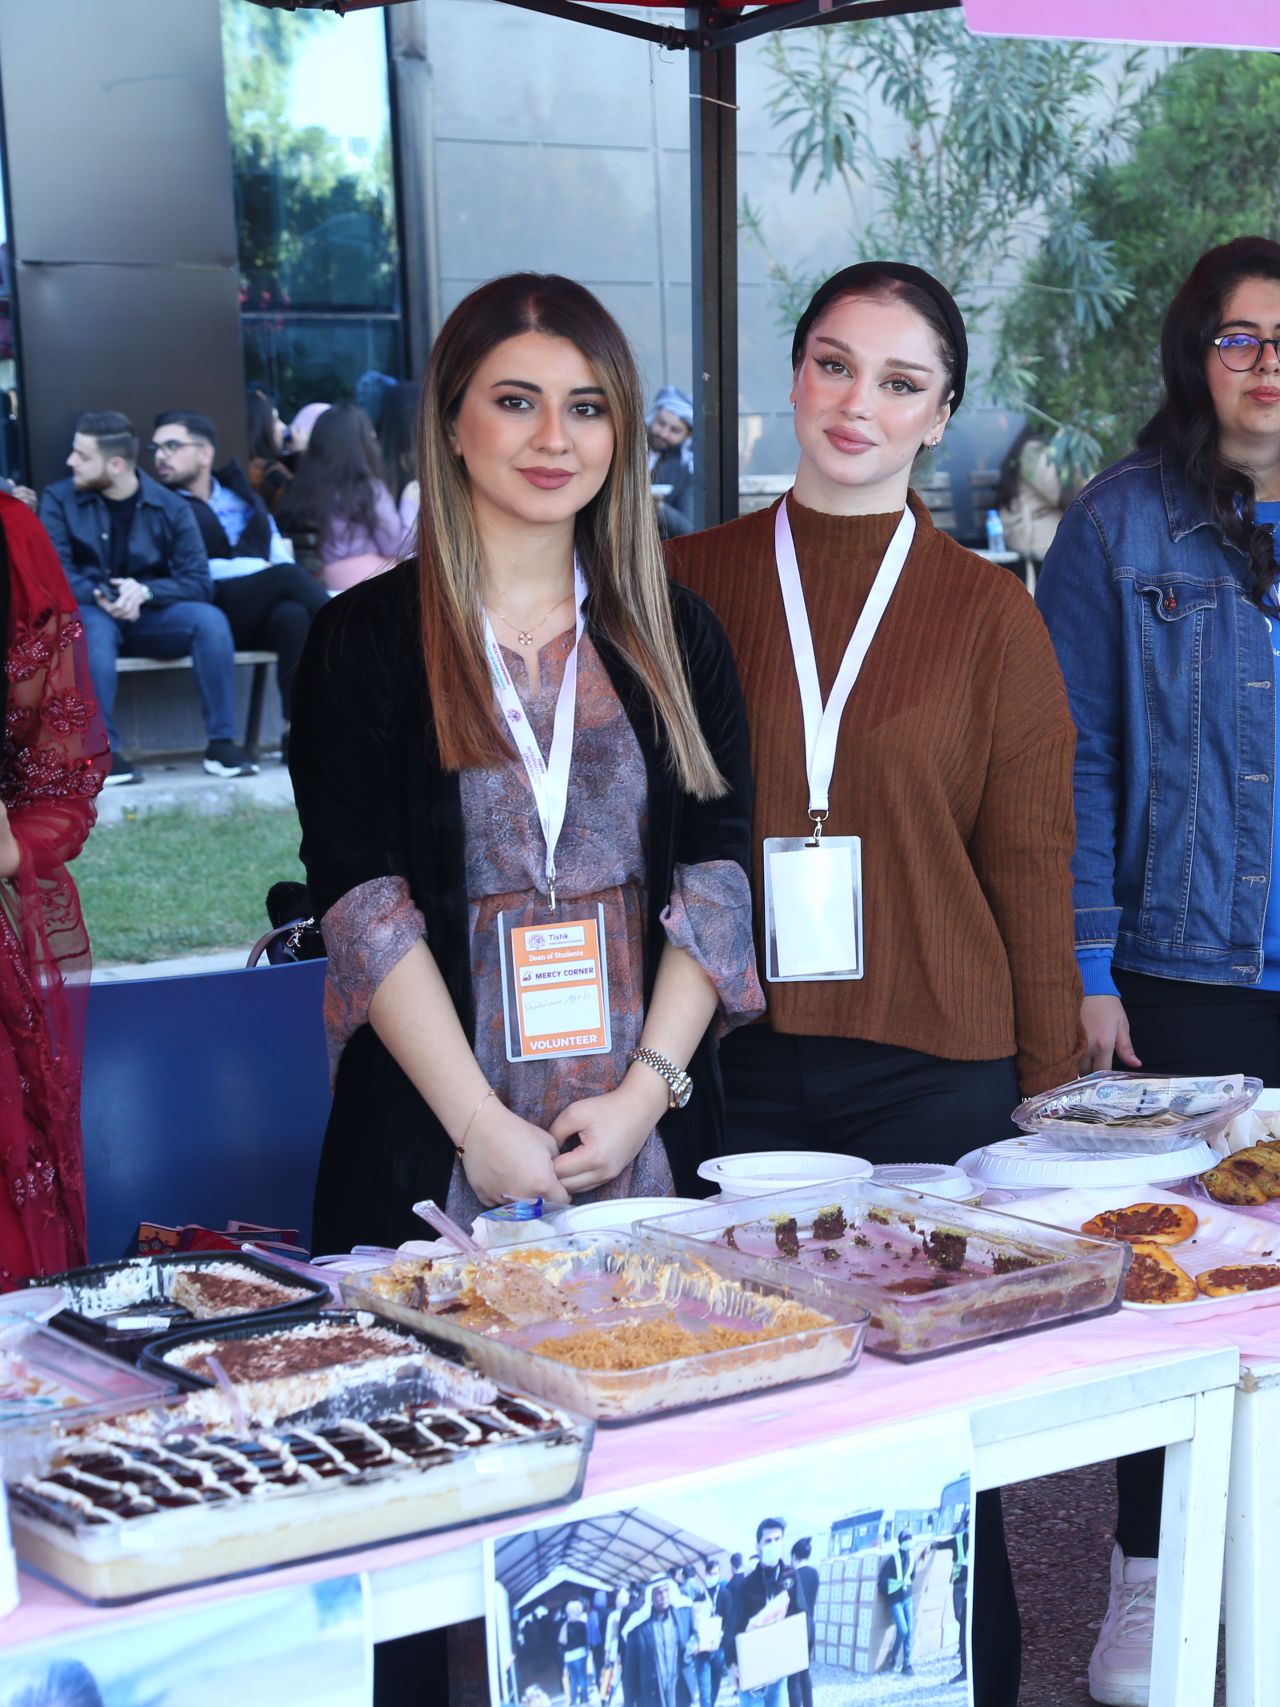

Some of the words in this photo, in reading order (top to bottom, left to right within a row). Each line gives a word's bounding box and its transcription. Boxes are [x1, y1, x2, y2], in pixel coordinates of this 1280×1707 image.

[535, 971, 561, 980] MERCY
[563, 967, 594, 977] CORNER
[530, 1034, 597, 1050] VOLUNTEER
